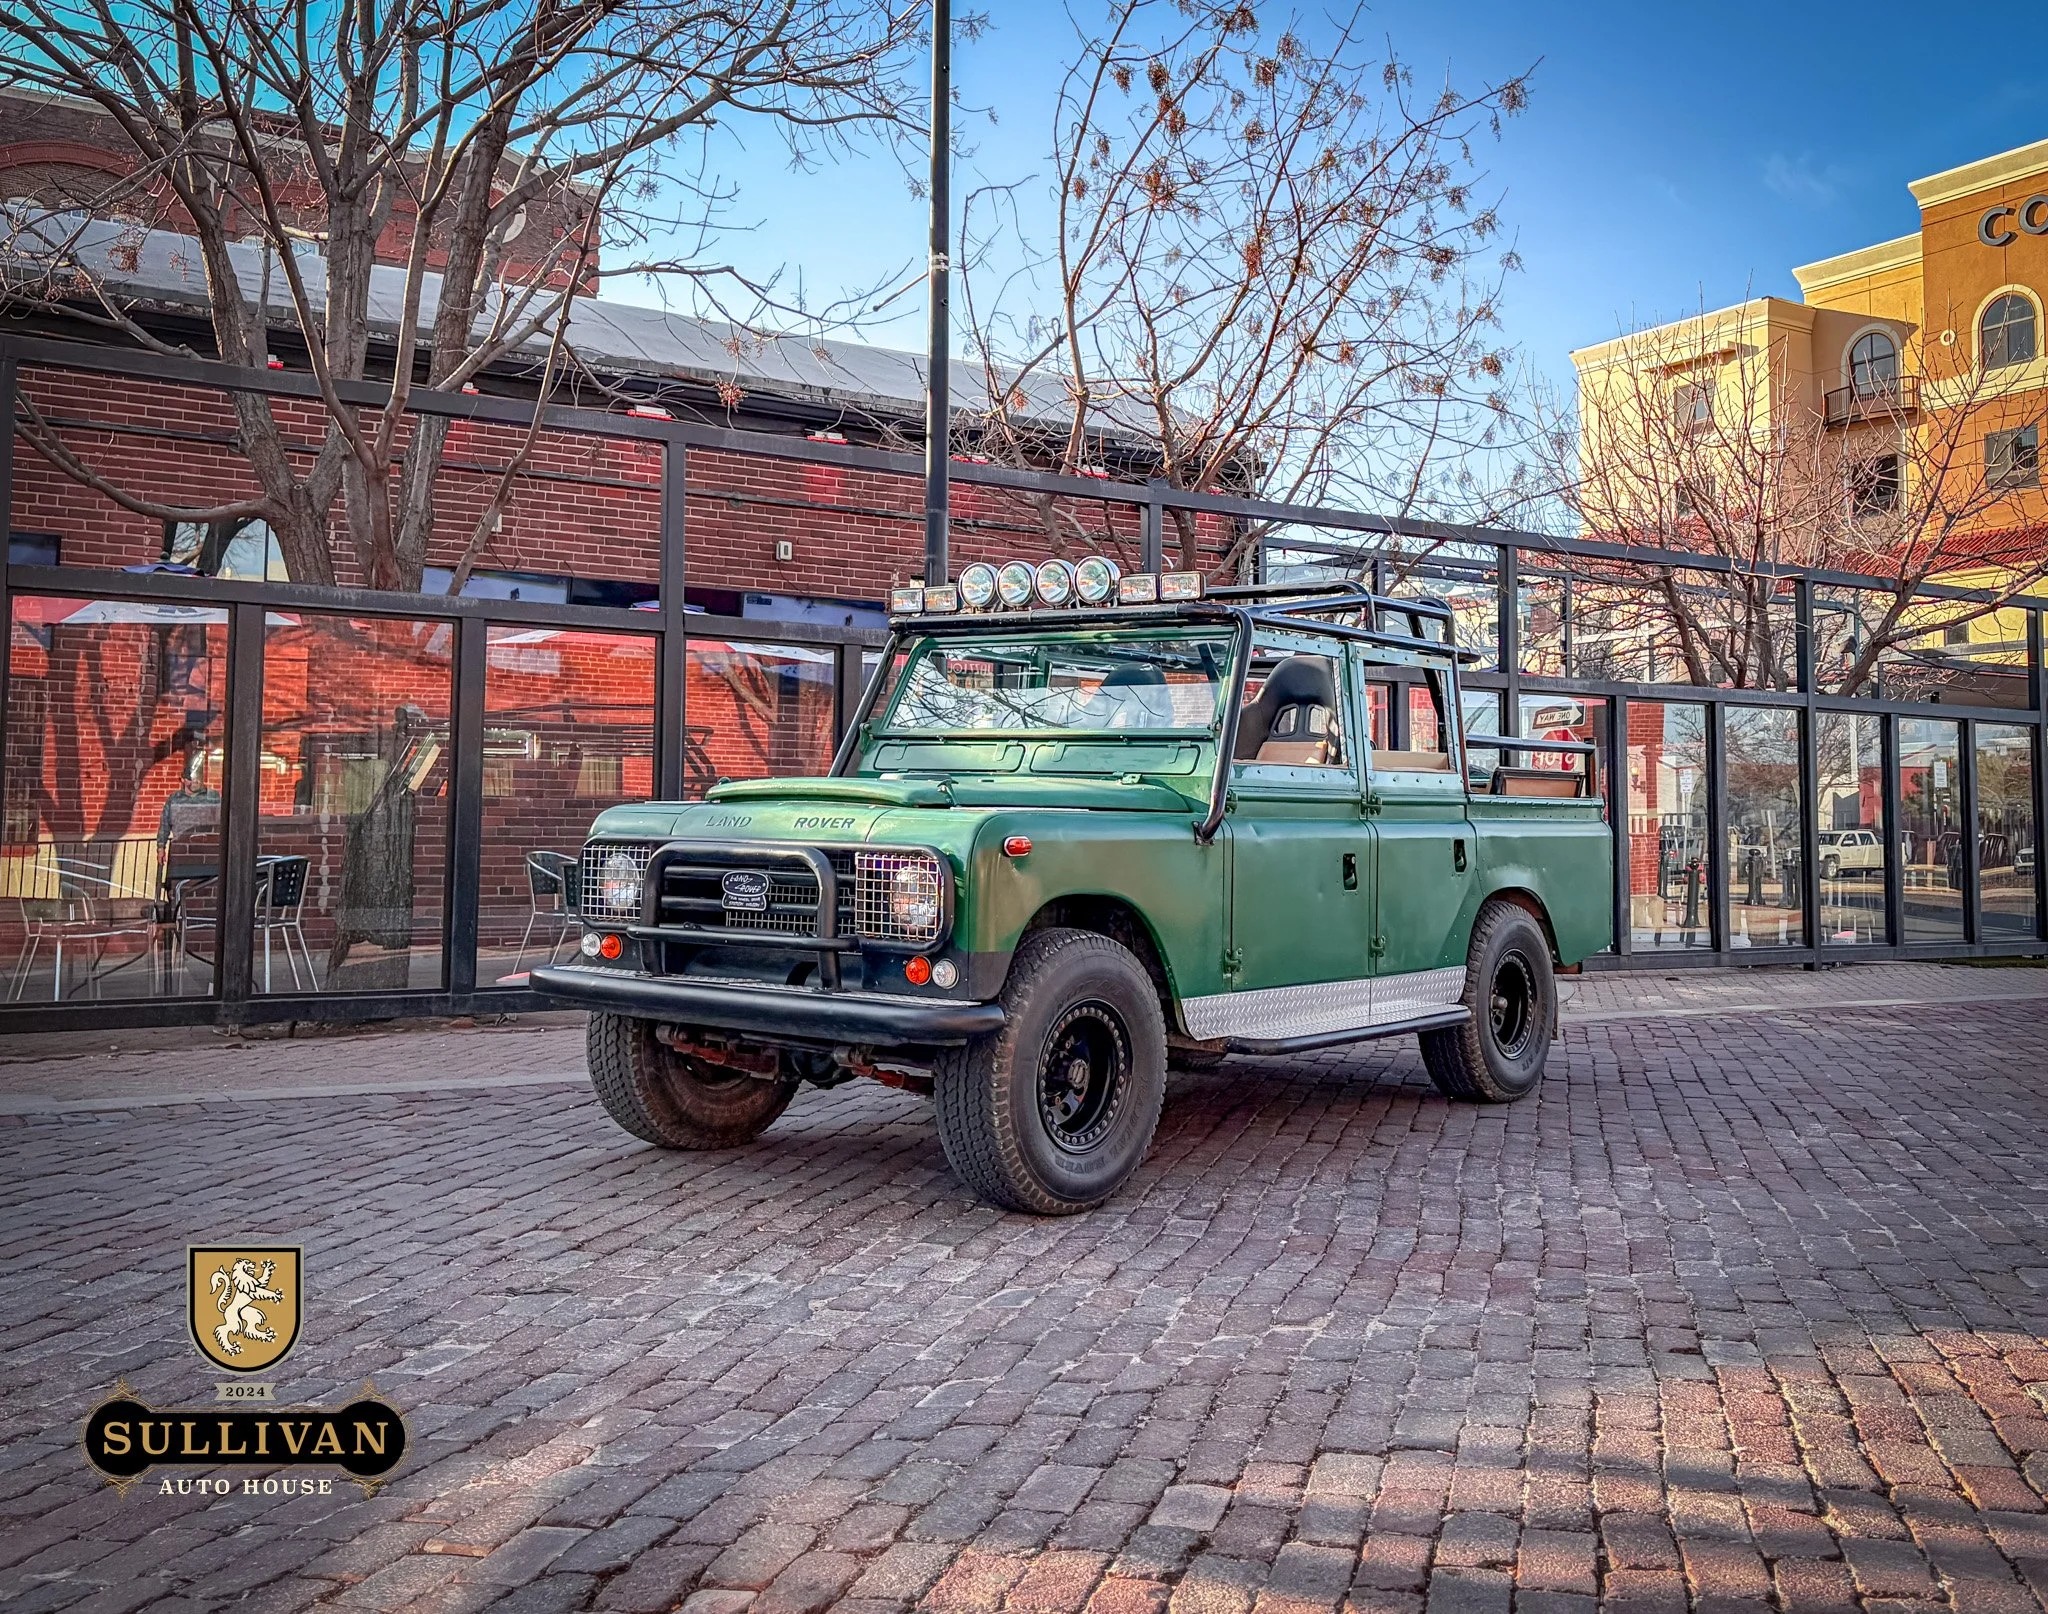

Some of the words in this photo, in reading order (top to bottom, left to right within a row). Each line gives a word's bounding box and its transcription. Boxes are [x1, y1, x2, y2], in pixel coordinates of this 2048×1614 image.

[1978, 194, 2048, 247] CO
[705, 815, 752, 828] LAND
[794, 816, 856, 829] ROVER
[730, 874, 749, 883] LAND
[740, 885, 762, 893] ROVER
